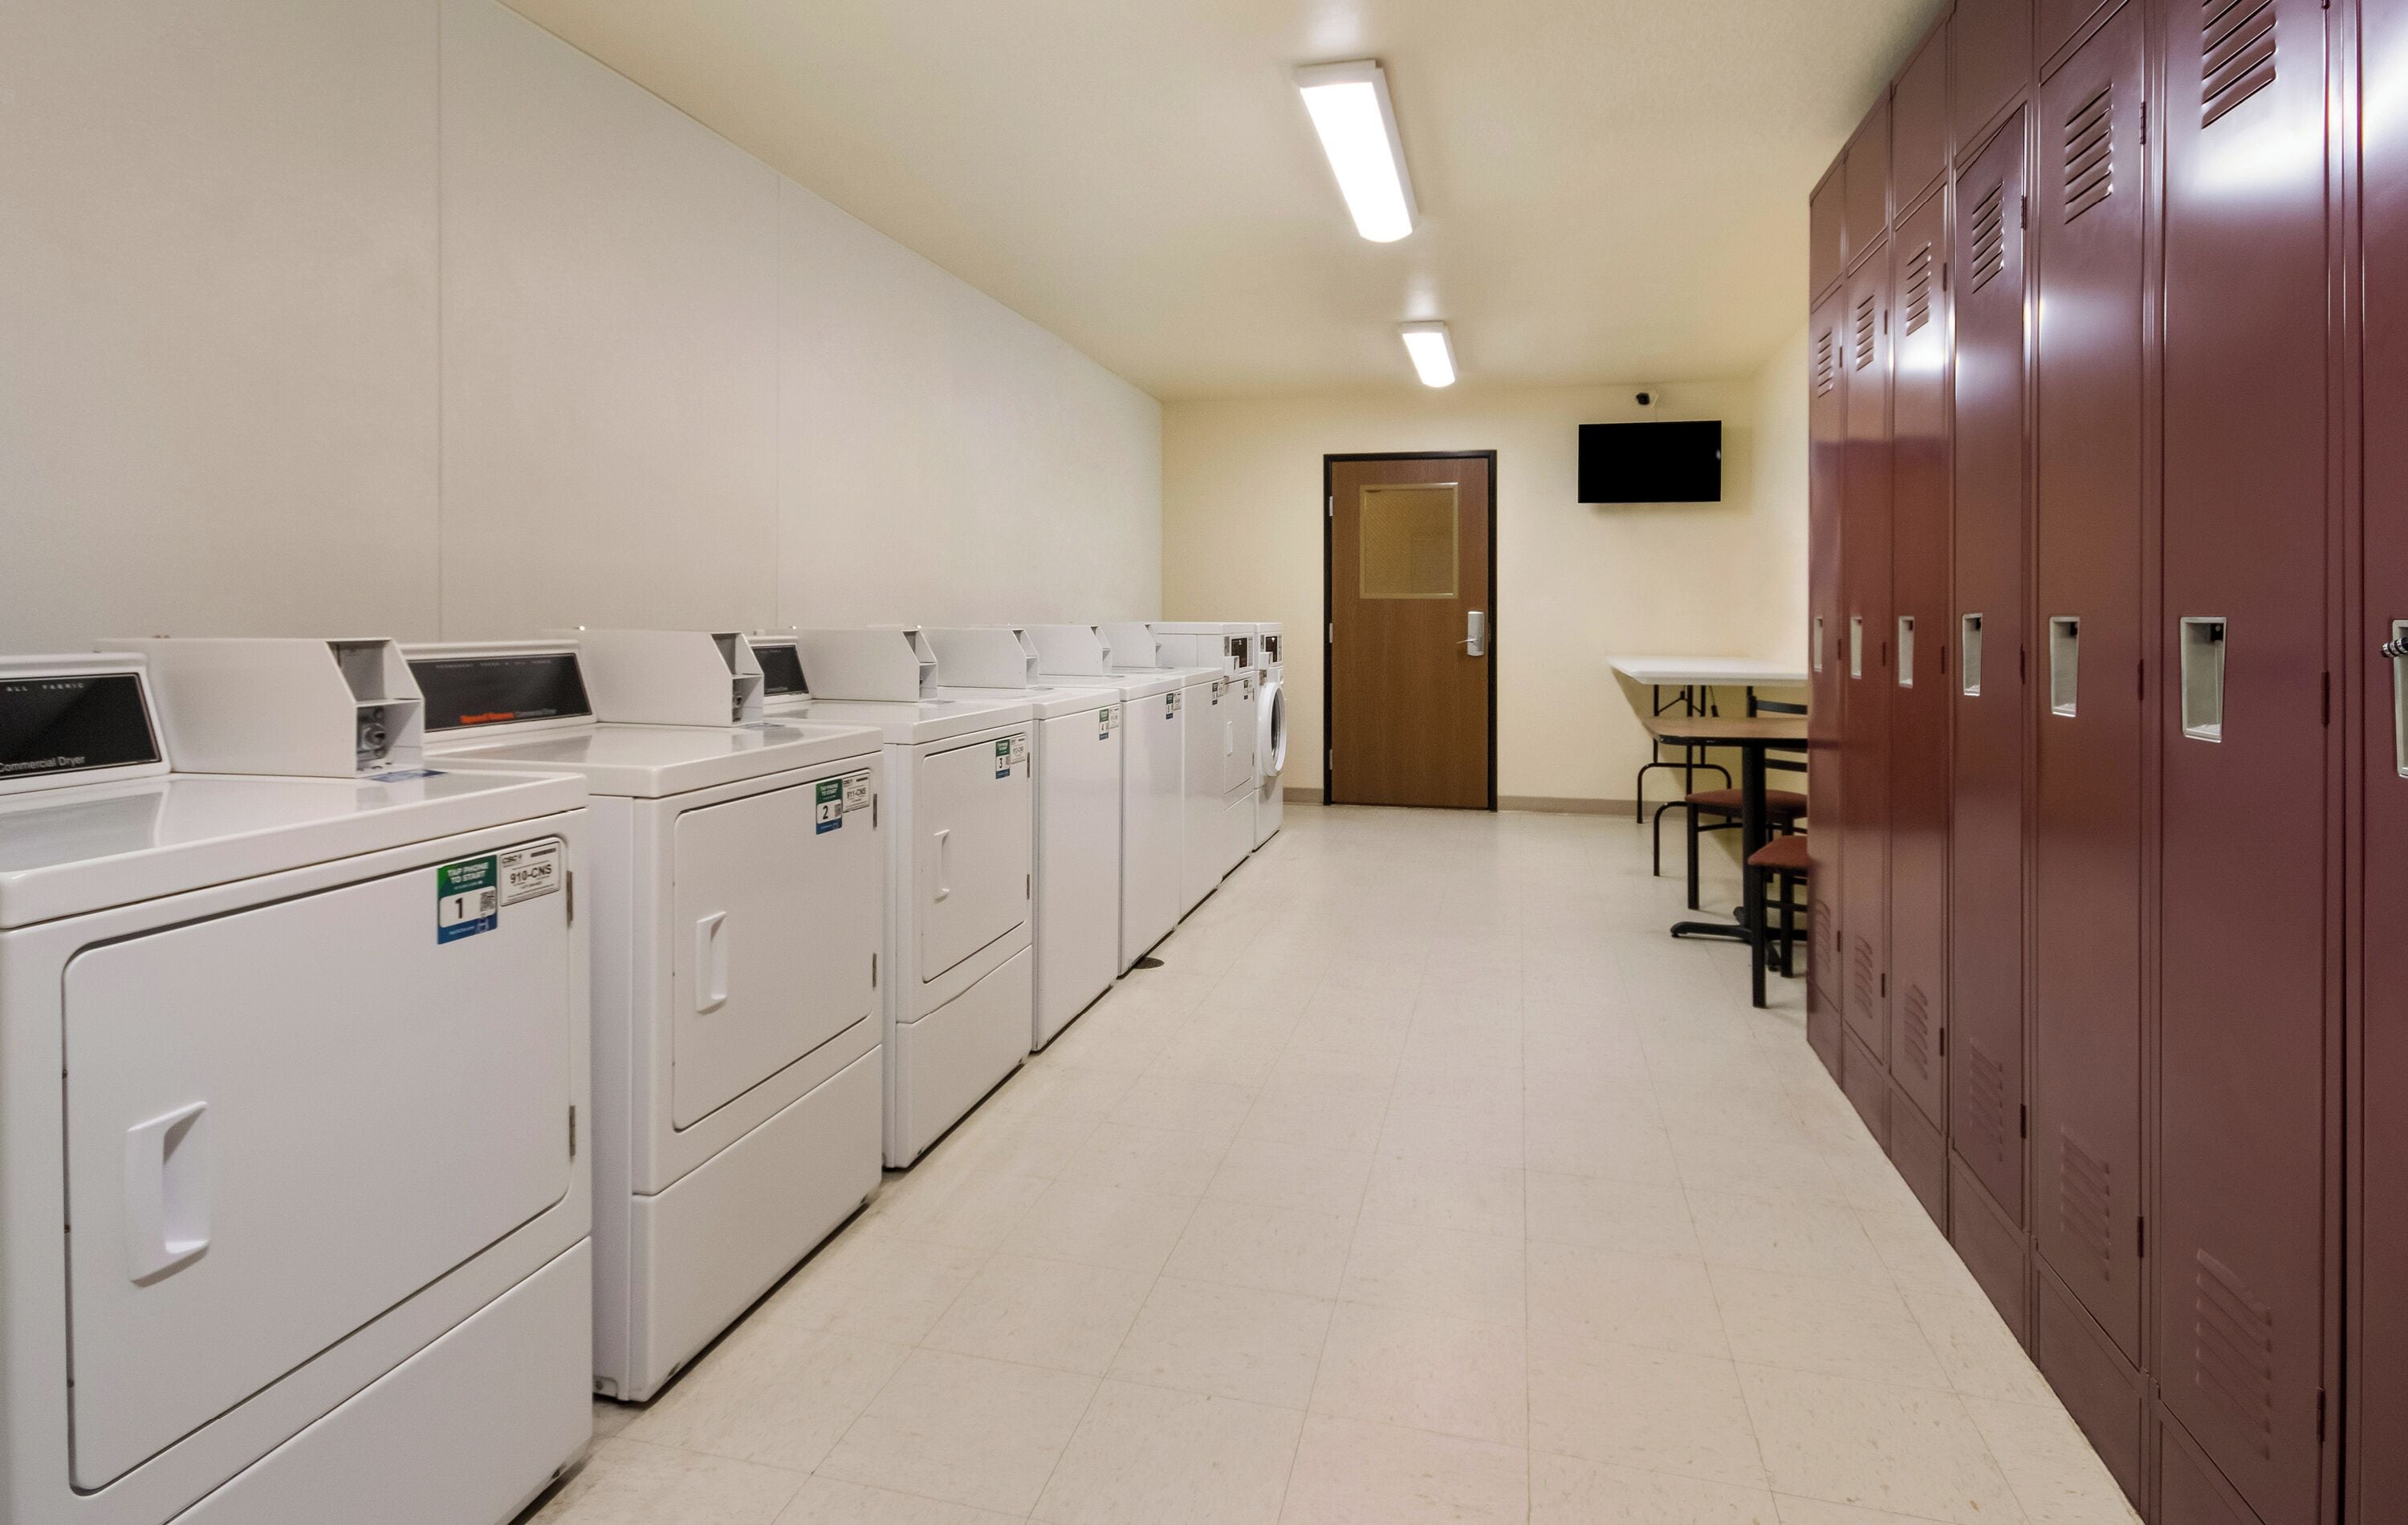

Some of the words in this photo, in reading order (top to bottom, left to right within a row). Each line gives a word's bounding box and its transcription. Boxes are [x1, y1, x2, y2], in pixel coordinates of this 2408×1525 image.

[0, 758, 57, 771] Commercial
[57, 755, 86, 767] Dryer
[999, 758, 1003, 768] 3
[823, 805, 828, 819] 2
[447, 868, 463, 877] TAP
[463, 862, 489, 873] PHONE
[509, 864, 552, 885] 910-CNS
[450, 876, 462, 885] TO
[462, 871, 486, 881] START
[455, 897, 463, 918] 1
